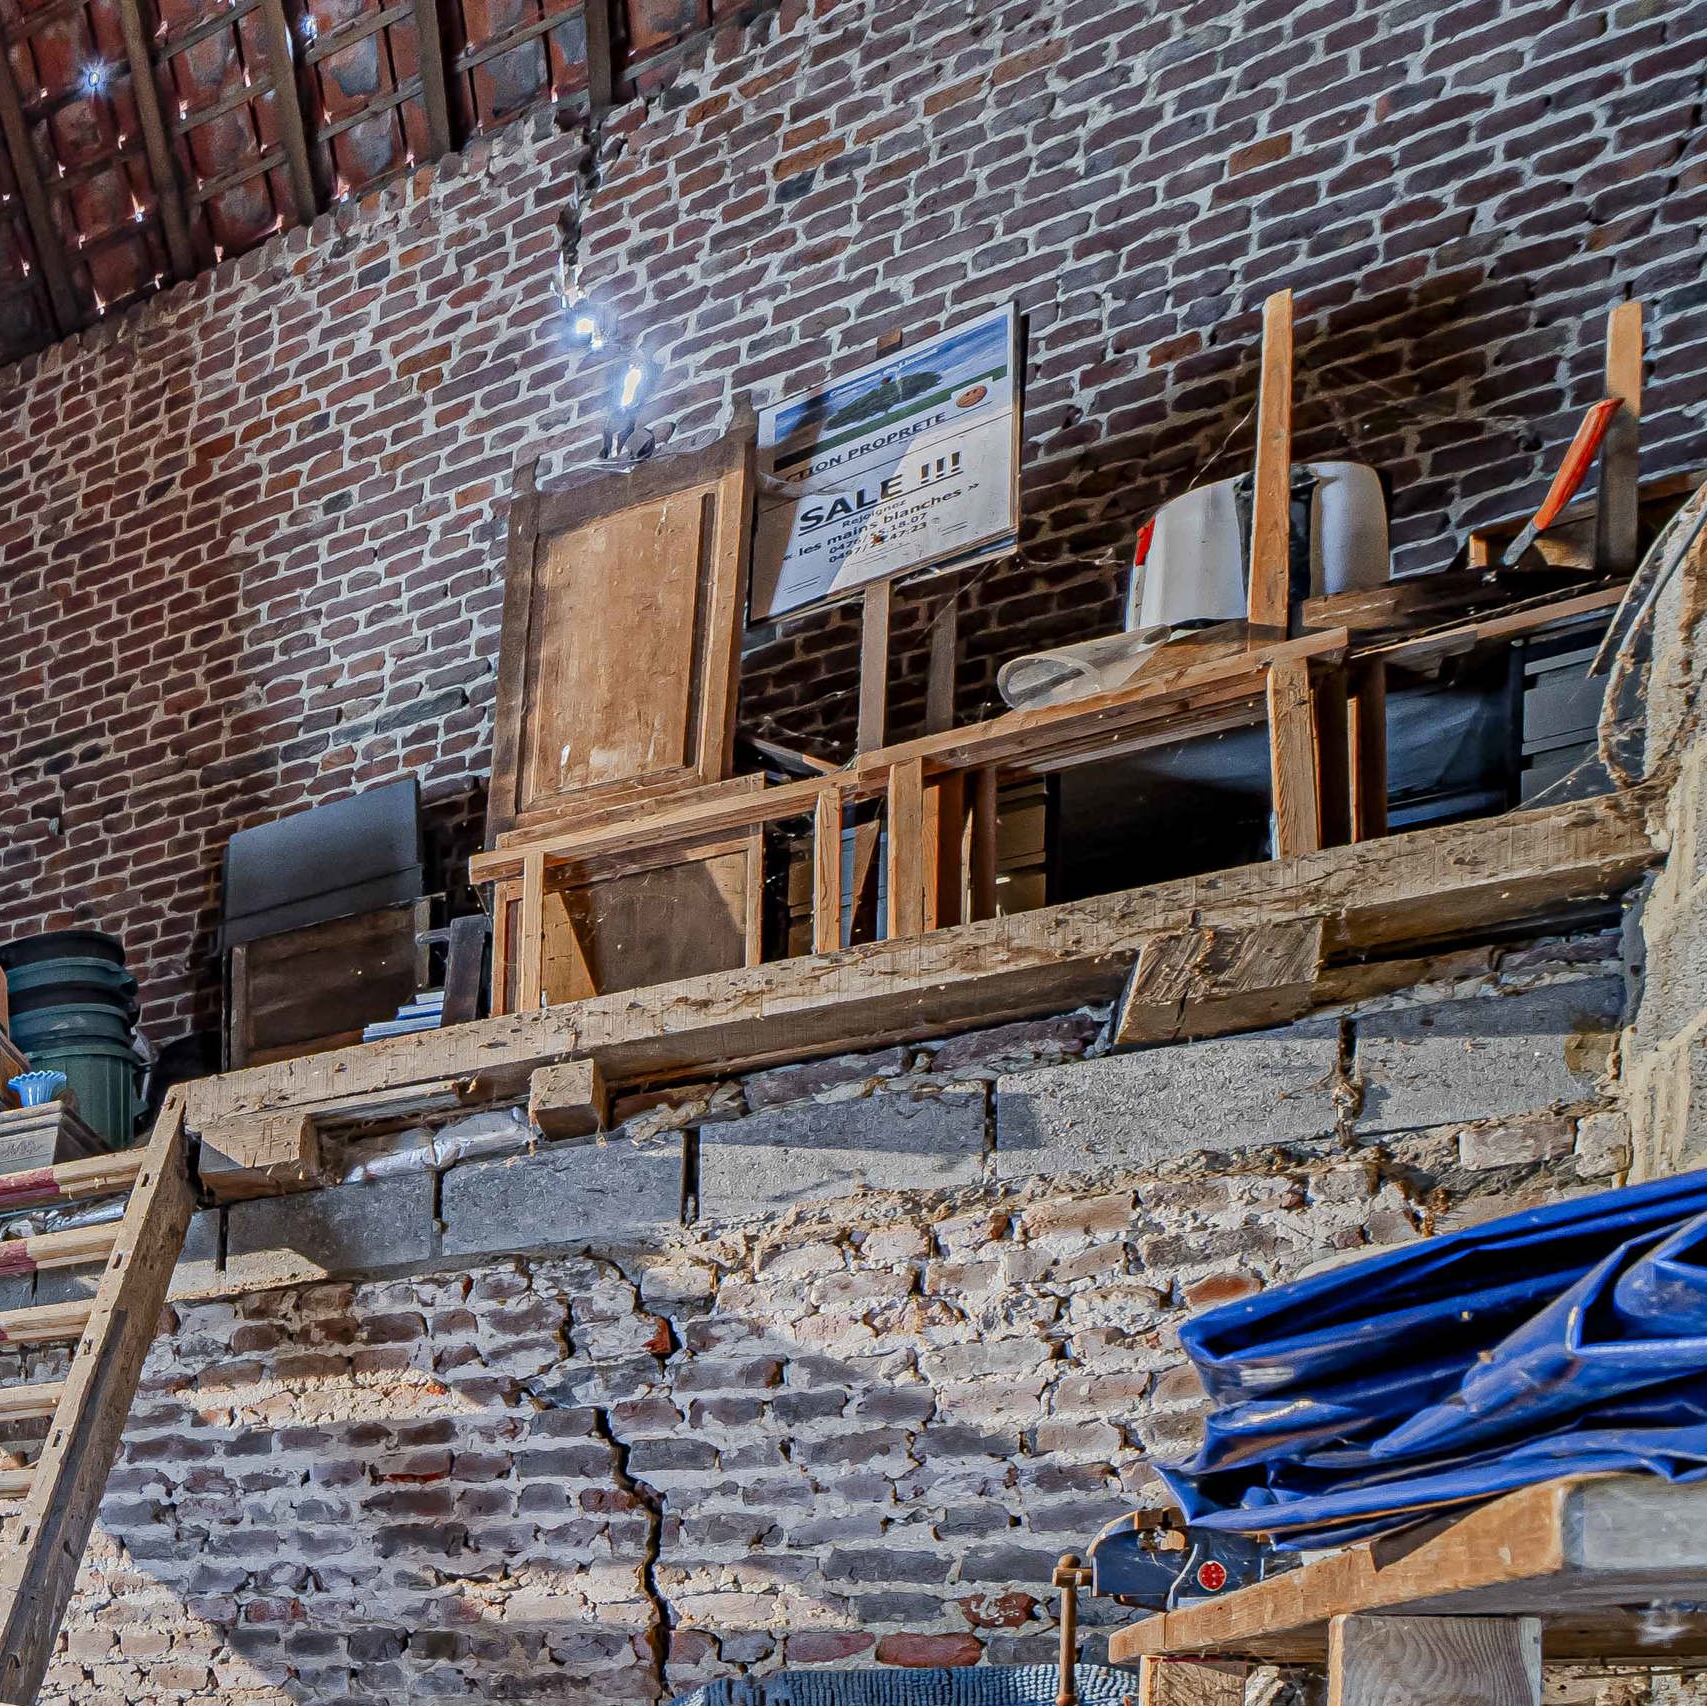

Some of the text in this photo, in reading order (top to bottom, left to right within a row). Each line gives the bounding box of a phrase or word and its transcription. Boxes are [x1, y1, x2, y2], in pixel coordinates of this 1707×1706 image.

[787, 411, 947, 482] CTION PROPRETE
[798, 451, 961, 531] SALE !!!
[798, 542, 822, 556] les
[827, 521, 878, 546] mains
[883, 489, 963, 526] blanches
[841, 499, 908, 529] Rejoignez
